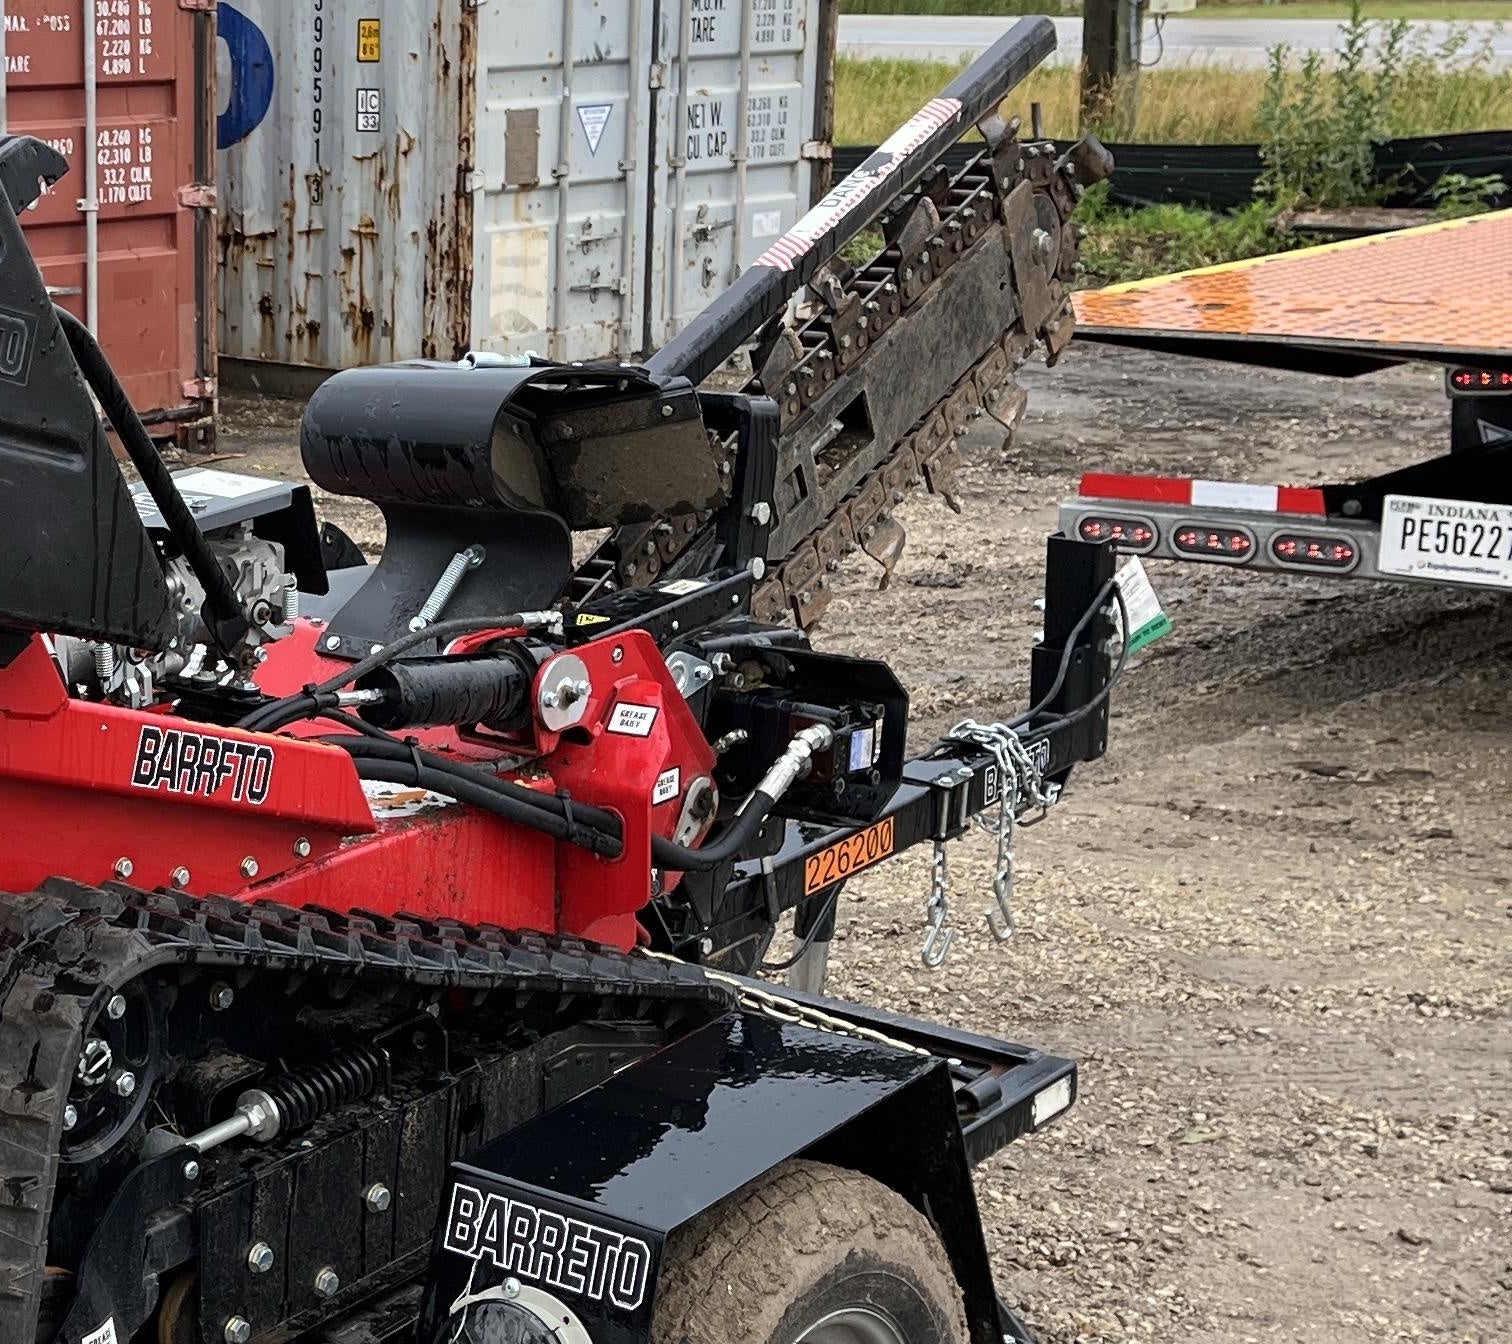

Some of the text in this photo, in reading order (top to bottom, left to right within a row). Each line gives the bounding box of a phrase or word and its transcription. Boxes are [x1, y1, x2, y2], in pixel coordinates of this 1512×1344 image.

[691, 16, 716, 43] TARE
[4, 55, 31, 72] TARE
[1428, 504, 1499, 522] INDIANA
[808, 820, 892, 892] 226200
[444, 1182, 651, 1311] BARRETO
